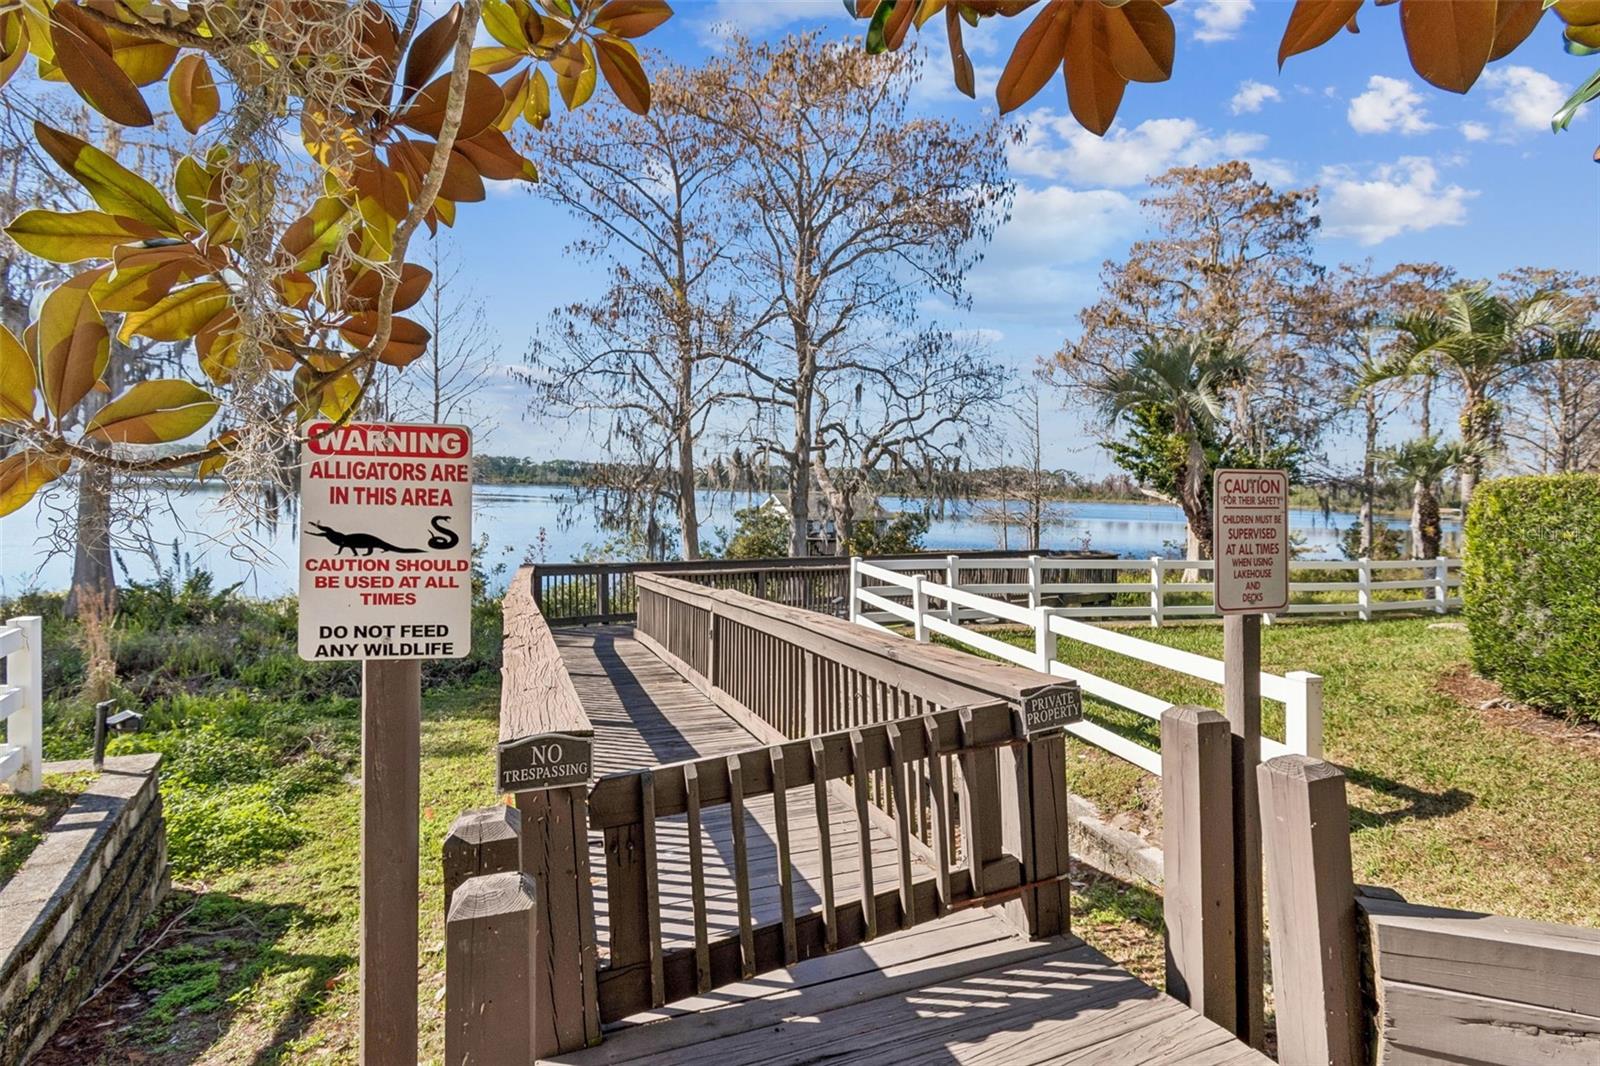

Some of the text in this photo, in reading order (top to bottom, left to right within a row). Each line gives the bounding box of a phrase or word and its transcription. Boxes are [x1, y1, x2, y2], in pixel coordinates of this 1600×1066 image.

[316, 429, 462, 454] WARNING
[309, 461, 468, 482] ALLIGATORS ARE
[1224, 479, 1280, 494] CAUTION
[330, 487, 453, 506] IN THIS AREA
[1238, 496, 1256, 505] THEIR
[1222, 515, 1282, 524] CHILDREN MUST BE
[1228, 528, 1276, 539] SUPERVISED
[1226, 544, 1279, 555] AT ALL TIMES
[305, 559, 469, 571] CAUTION SHOULD
[1232, 558, 1273, 566] WHEN USING
[1234, 569, 1271, 579] LAKEHOUSE
[314, 577, 459, 588] BE USED AT ALL
[1246, 582, 1260, 590] AND
[360, 593, 416, 605] TIMES
[1243, 593, 1263, 602] DECKS
[319, 625, 448, 638] DO NOT FEED
[315, 643, 454, 657] ANY WILDLIFE
[1032, 692, 1074, 711] PRIVATE
[1027, 703, 1079, 725] PROPERTY
[531, 744, 562, 765] NO
[503, 762, 588, 783] TRESPASSING
